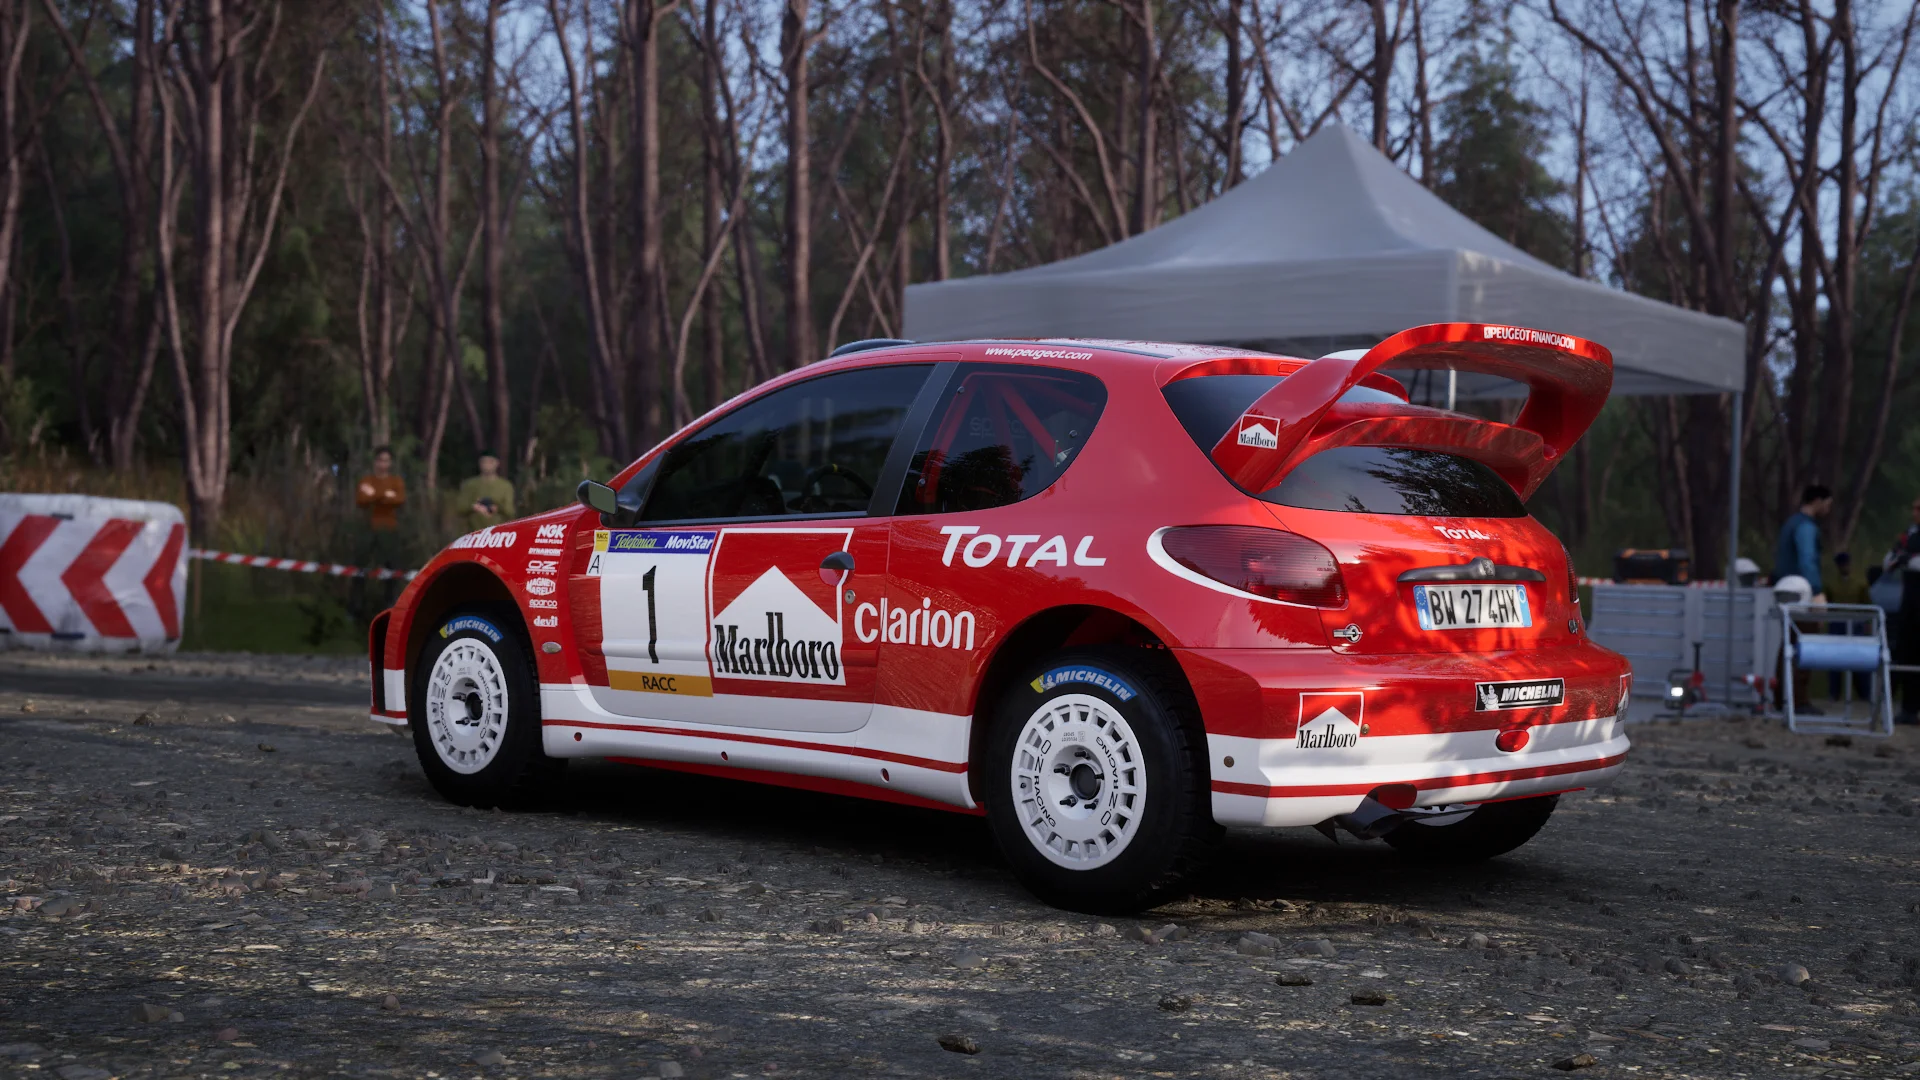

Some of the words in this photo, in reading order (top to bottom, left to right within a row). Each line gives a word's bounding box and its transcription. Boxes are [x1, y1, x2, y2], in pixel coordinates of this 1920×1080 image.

[1491, 327, 1531, 341] PEUGEOT
[1531, 331, 1575, 350] FINANCIACION
[985, 348, 1092, 360] www.peugeot.com
[1239, 432, 1276, 448] Marlboro
[536, 524, 567, 539] NGK
[664, 534, 713, 550] MoviStar
[1433, 525, 1490, 540] TOTAL
[939, 525, 1107, 568] TOTAL
[588, 554, 600, 574] A
[642, 565, 659, 664] 1
[1428, 590, 1457, 625] BW
[454, 619, 500, 643] MICHELIN
[533, 615, 558, 628] devil
[854, 597, 975, 651] Clarion
[714, 611, 839, 681] Marlboro
[642, 675, 677, 692] RACC
[1055, 670, 1132, 702] MICHELIN
[1501, 684, 1560, 702] MICHELIN
[1296, 724, 1357, 749] Marlboro
[1096, 736, 1119, 790] RACING
[1033, 775, 1057, 828] RACING
